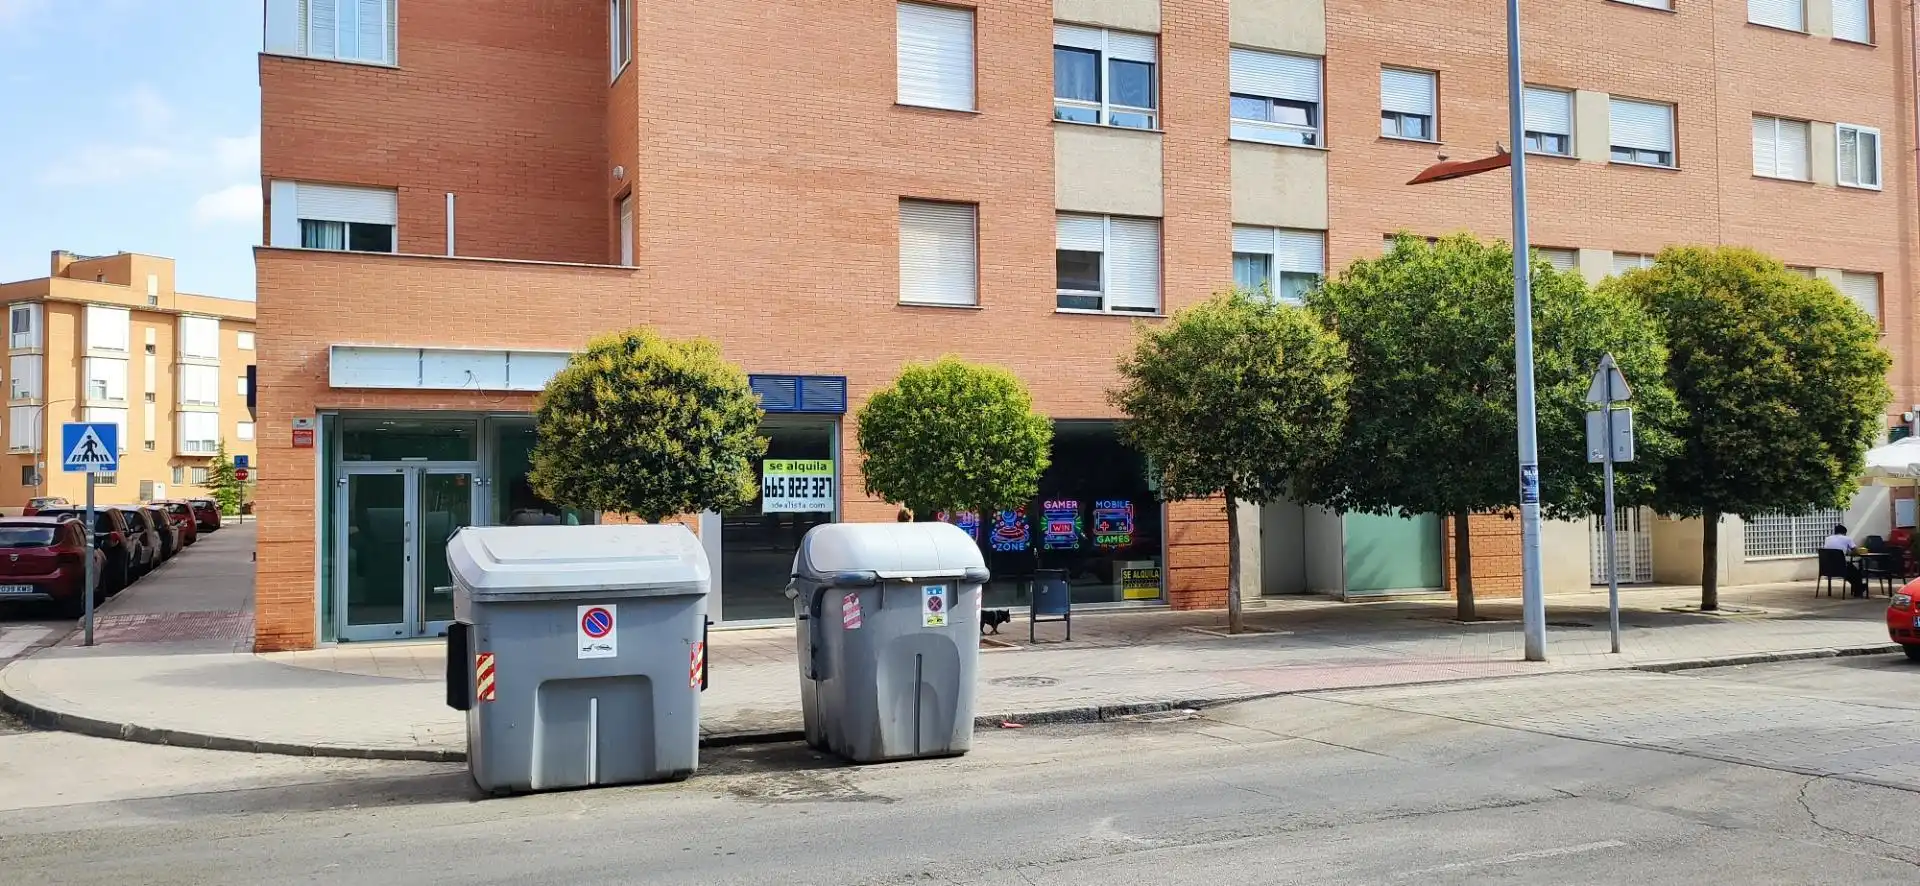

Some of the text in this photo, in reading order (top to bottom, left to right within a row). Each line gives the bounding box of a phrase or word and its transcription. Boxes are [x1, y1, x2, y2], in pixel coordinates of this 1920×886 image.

[769, 461, 827, 472] se alquila
[764, 477, 832, 498] 665 822 327
[1044, 500, 1078, 509] GAMER
[1095, 500, 1130, 509] MOBILE
[1052, 524, 1070, 532] WIN
[1097, 535, 1130, 543] GAMES
[996, 543, 1025, 551] ZONE
[1123, 570, 1132, 579] SE
